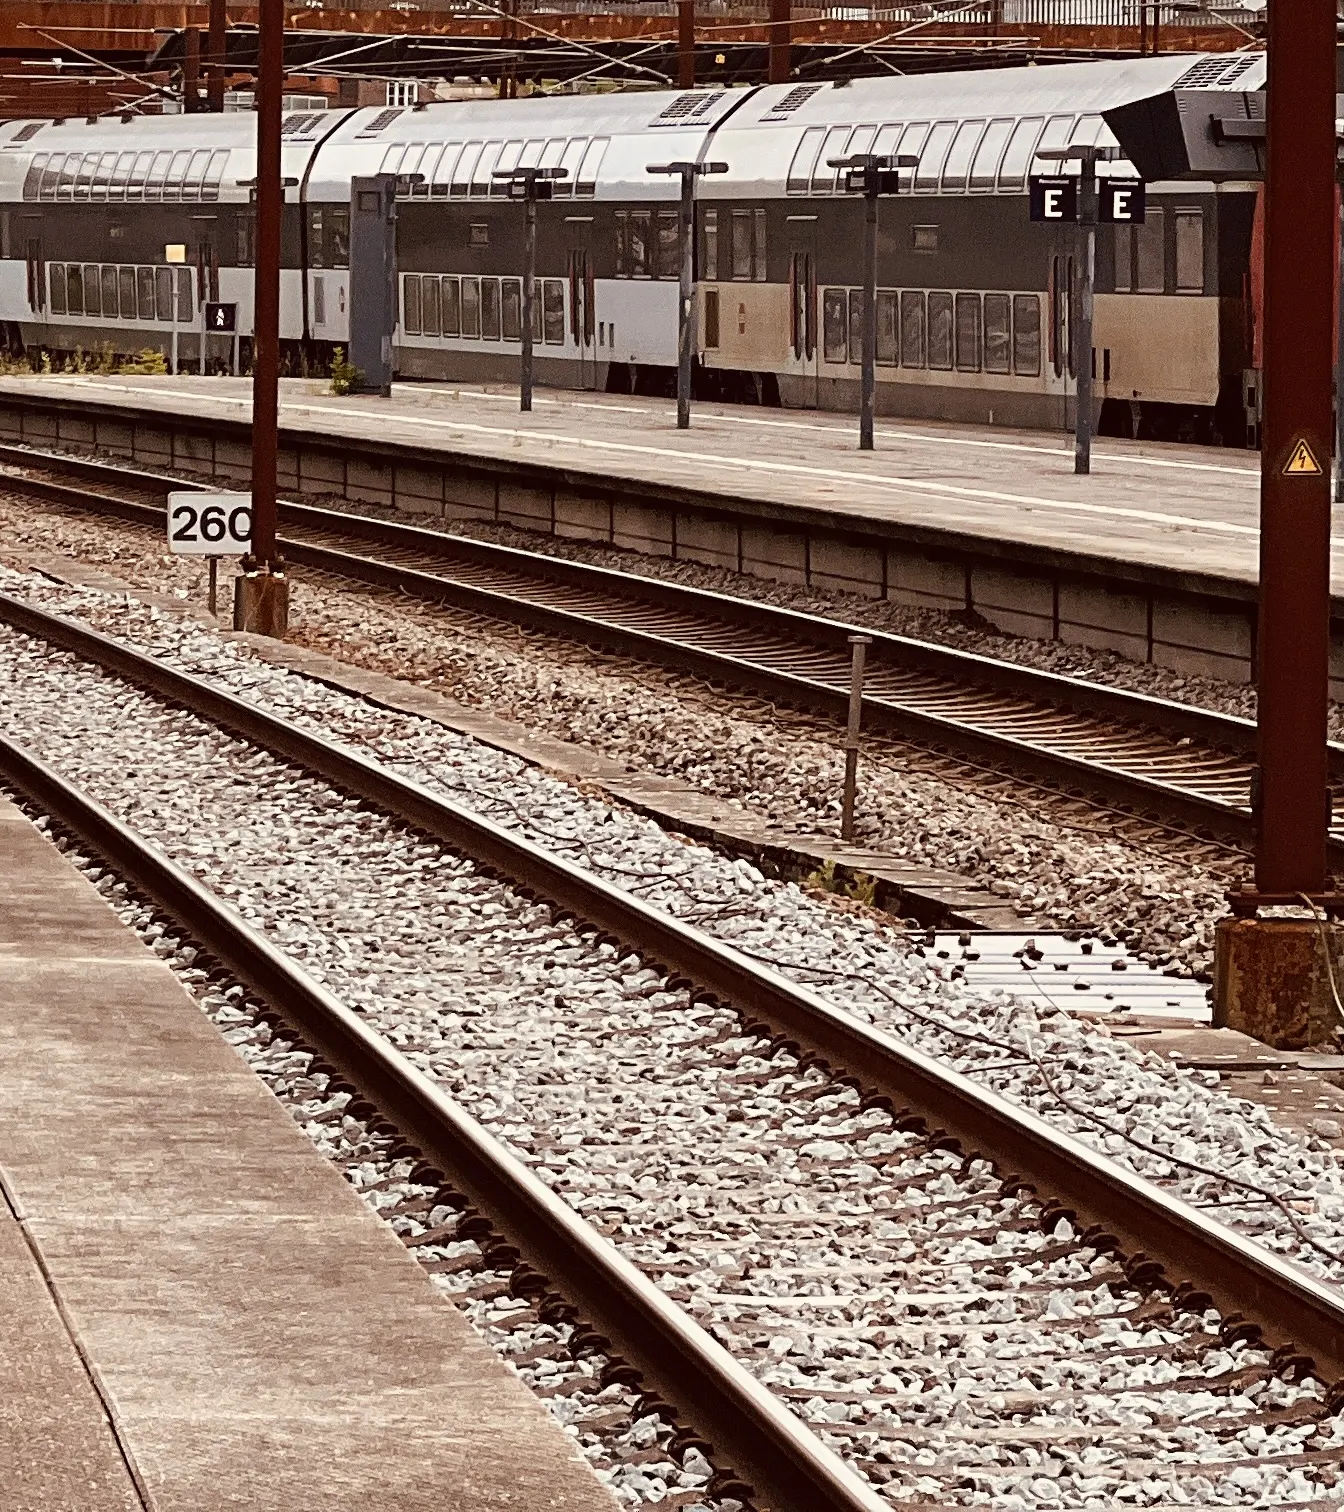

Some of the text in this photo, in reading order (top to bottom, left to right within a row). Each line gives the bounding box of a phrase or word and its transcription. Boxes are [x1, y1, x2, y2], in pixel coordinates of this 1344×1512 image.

[1044, 189, 1063, 218] E
[1113, 191, 1132, 219] E
[172, 505, 253, 543] 260
